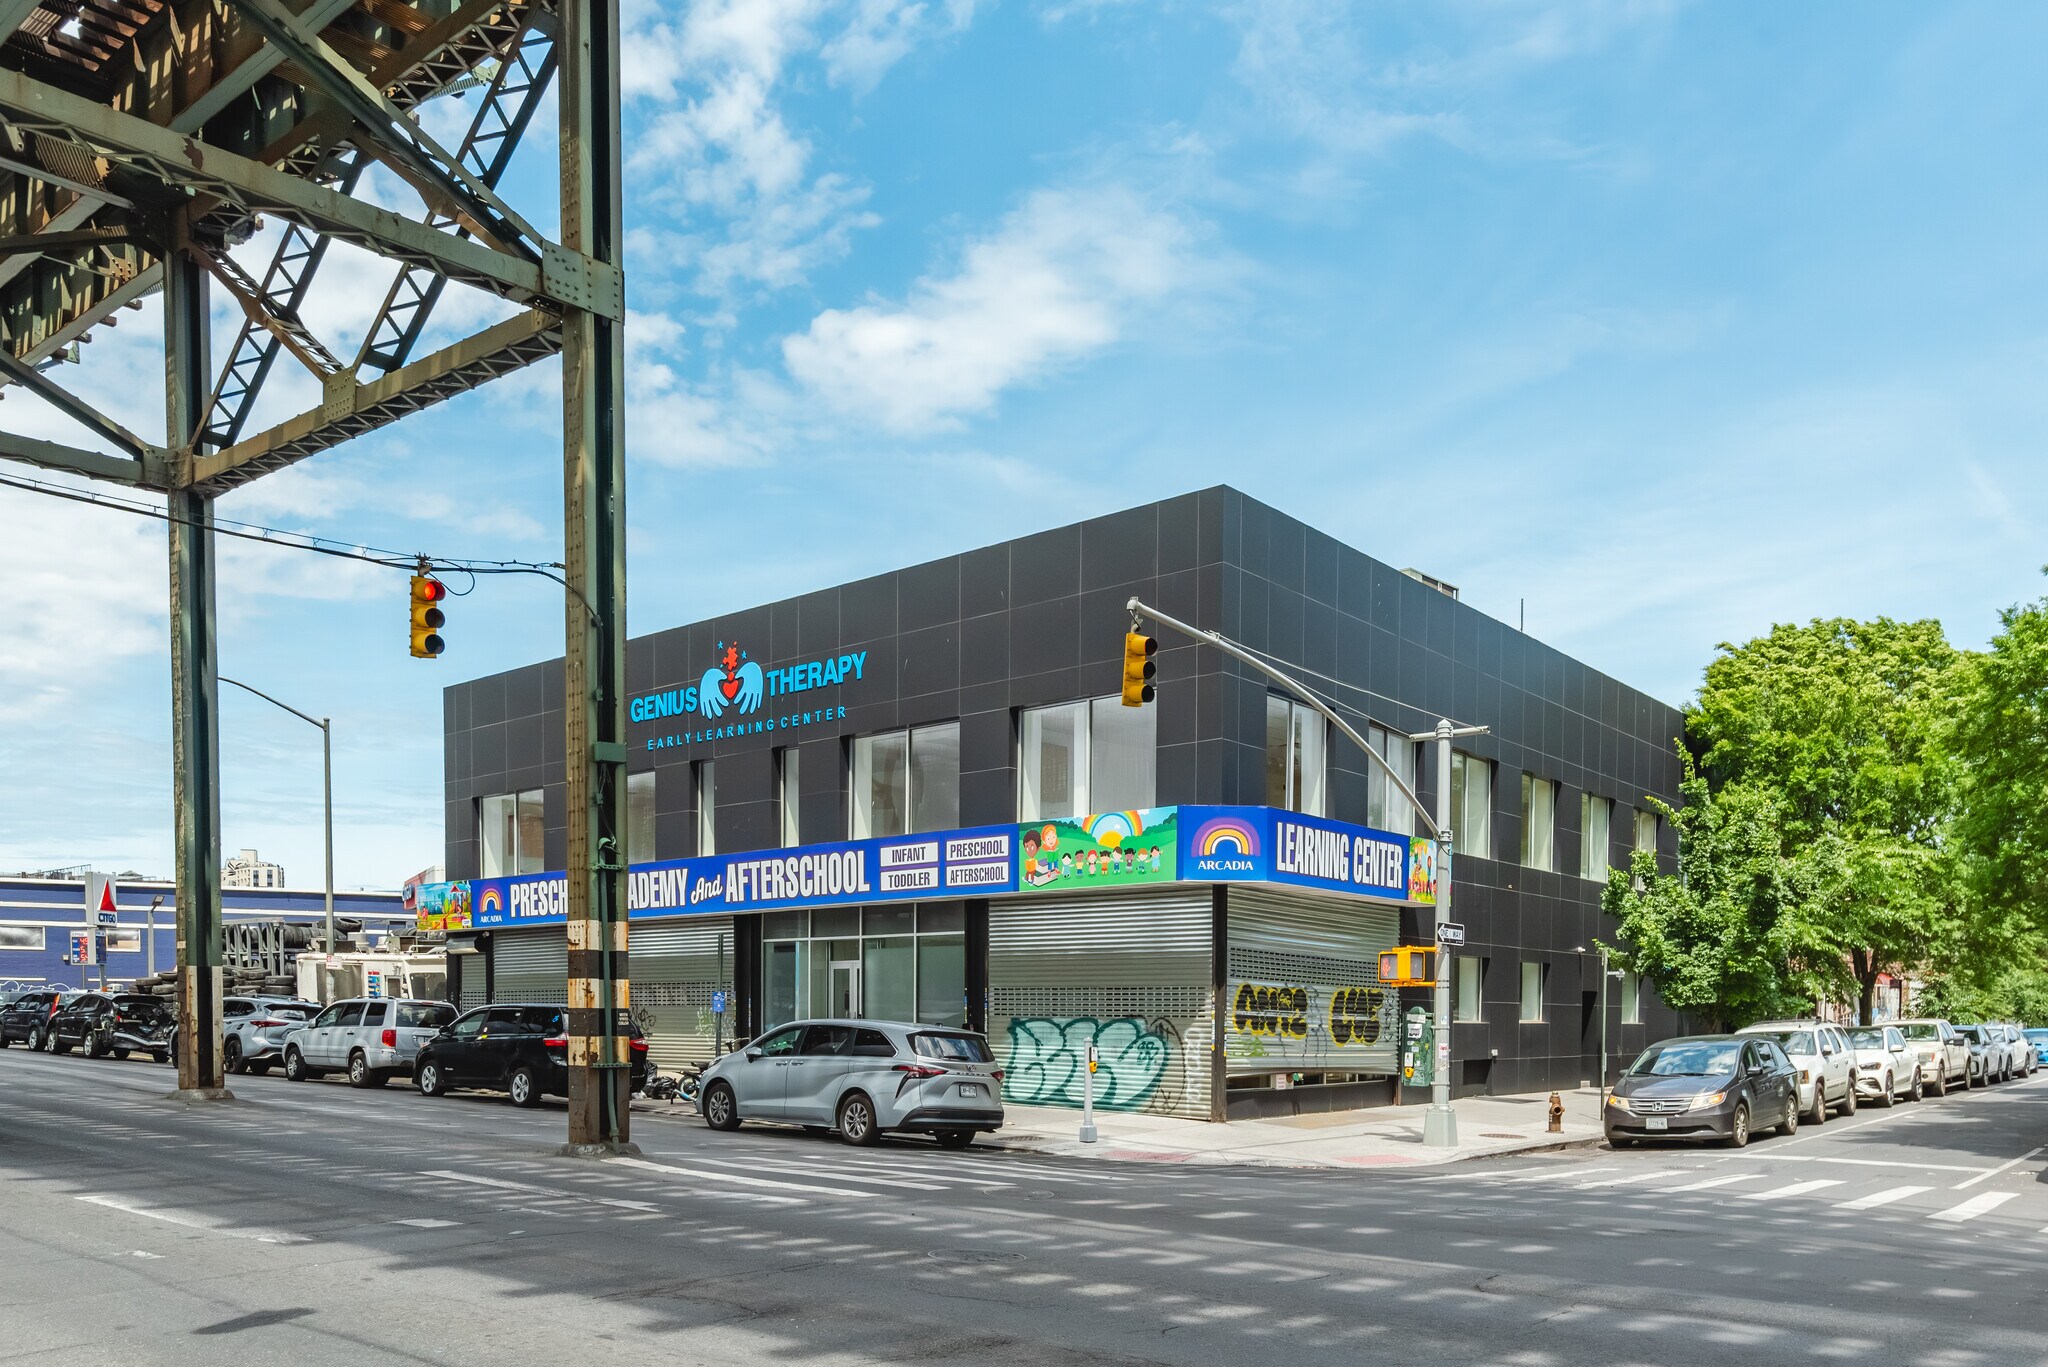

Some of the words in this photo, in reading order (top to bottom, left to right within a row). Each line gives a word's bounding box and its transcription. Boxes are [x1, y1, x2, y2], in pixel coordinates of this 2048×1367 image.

[630, 686, 697, 723] GENIUS
[766, 651, 867, 697] THERAPY
[647, 732, 691, 751] EARLY
[697, 718, 774, 743] LEARNING
[780, 706, 846, 729] CENTER
[891, 846, 926, 863] INFANT
[950, 839, 1005, 858] PRESCHOOL
[1276, 821, 1349, 882] LEARNING
[1353, 836, 1402, 889] CENTER
[950, 864, 1006, 883] AFTERSCHOOL
[1198, 860, 1254, 871] ARCADIA
[690, 874, 724, 904] And
[725, 850, 870, 903] AFTERSCHOOL
[888, 871, 931, 888] TODDLER
[98, 913, 116, 923] CITGO
[480, 915, 503, 923] ARCADIA
